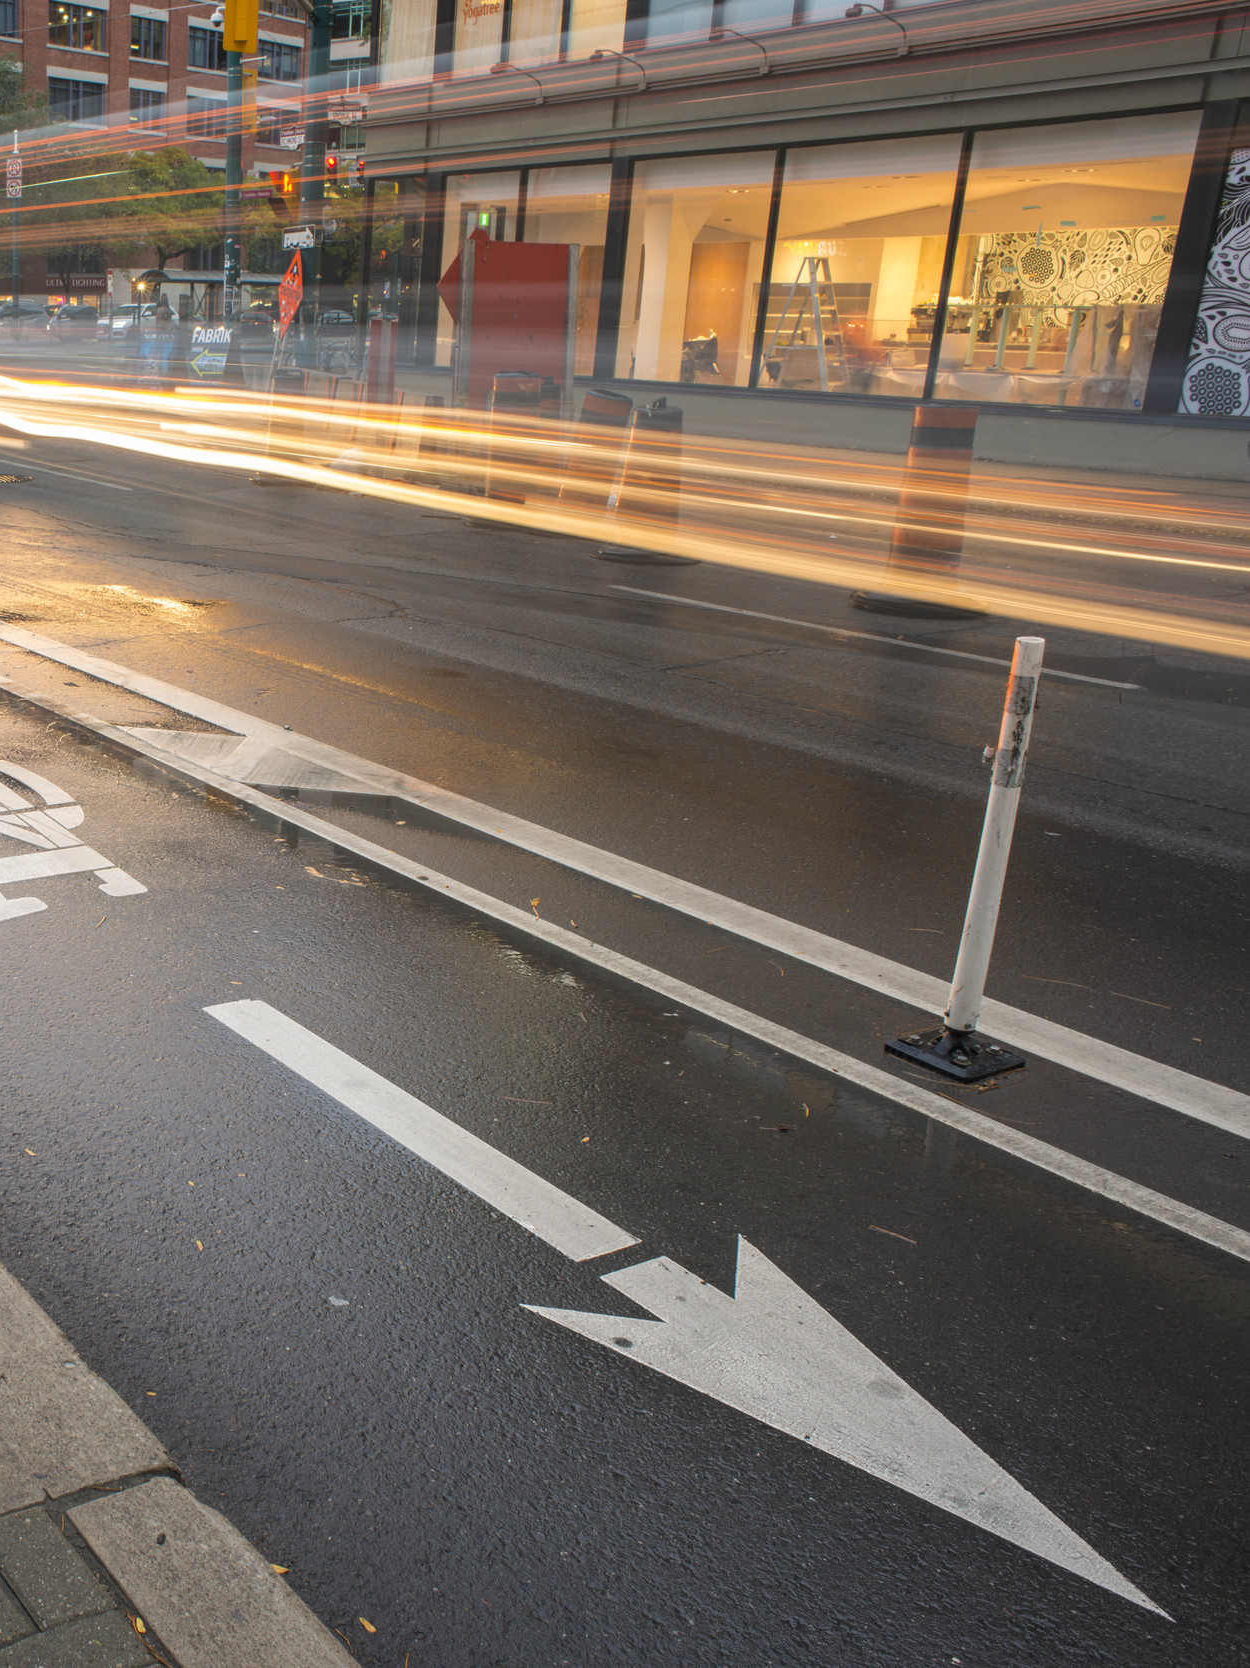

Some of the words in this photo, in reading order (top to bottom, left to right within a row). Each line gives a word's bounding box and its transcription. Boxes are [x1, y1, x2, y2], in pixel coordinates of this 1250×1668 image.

[463, 3, 501, 26] yogatree
[72, 279, 105, 287] LIGHTING
[191, 329, 232, 344] FABRIK
